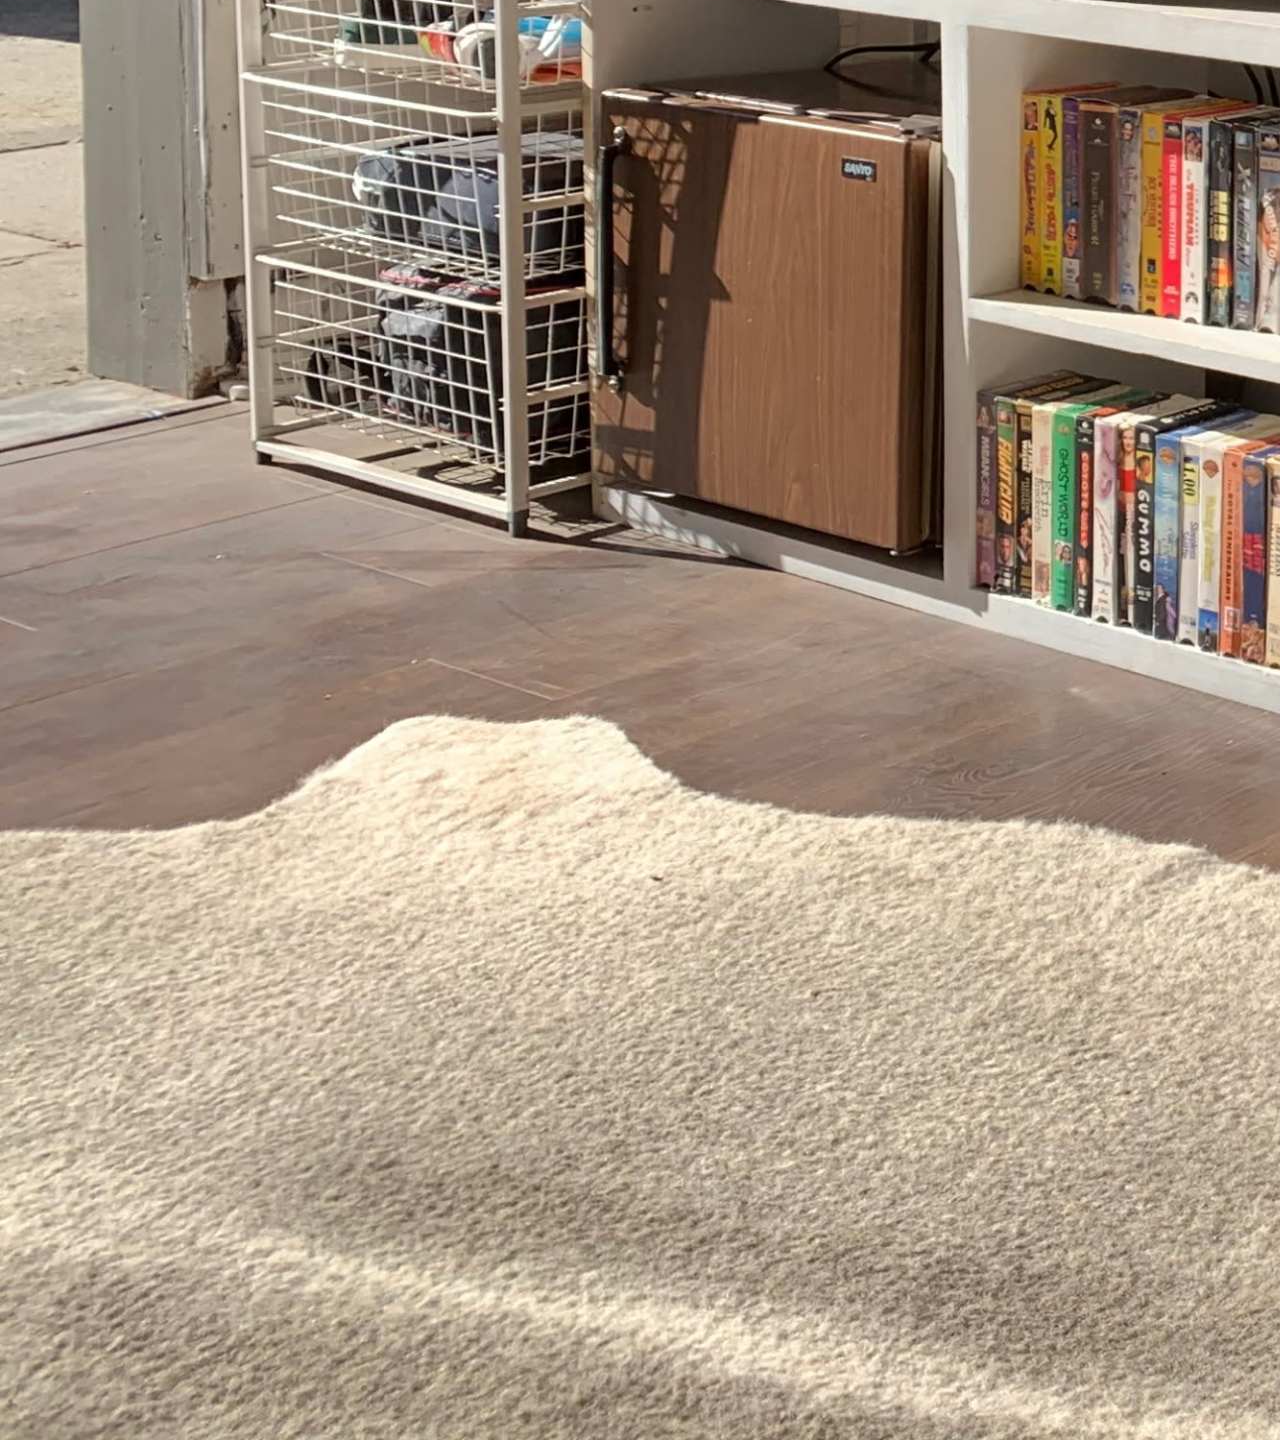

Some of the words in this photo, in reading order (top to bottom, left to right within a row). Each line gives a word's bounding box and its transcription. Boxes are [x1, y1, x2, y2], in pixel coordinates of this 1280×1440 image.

[844, 162, 873, 177] SANYO
[1169, 154, 1177, 173] THE
[1186, 183, 1195, 246] TRUMAN
[1235, 162, 1251, 268] X-MEN
[981, 436, 991, 475] MEAN
[998, 437, 1012, 481] FIGHT
[1058, 448, 1068, 492] GHOST
[981, 476, 990, 505] GIRLS
[1000, 482, 1012, 524] CLUB
[1041, 479, 1053, 517] Erin
[1183, 467, 1197, 497] 1.00
[1058, 494, 1068, 537] WORLD
[1138, 489, 1151, 573] GUMMO
